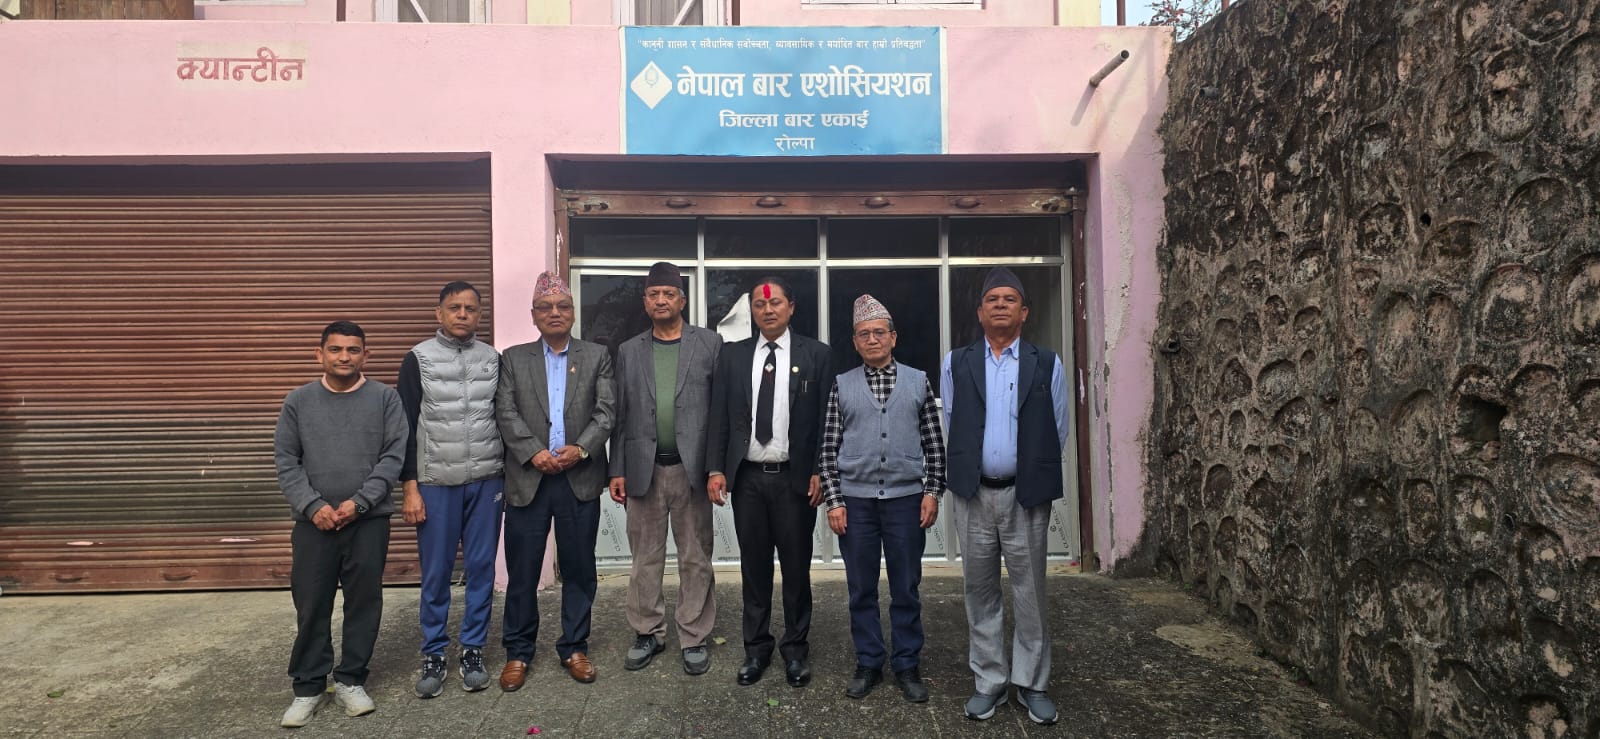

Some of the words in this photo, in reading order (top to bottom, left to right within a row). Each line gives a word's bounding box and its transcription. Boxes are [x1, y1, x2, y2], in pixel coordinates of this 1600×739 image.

[690, 40, 697, 50] र
[817, 40, 824, 49] र
[856, 40, 869, 50] बार
[177, 46, 306, 83] क्यान्टीन
[677, 65, 746, 98] नेपाल
[753, 73, 793, 98] बार
[800, 64, 933, 98] एशोसियशन
[719, 109, 780, 128] जिल्ला
[784, 113, 816, 128] बार
[821, 109, 870, 129] एकाई
[774, 134, 816, 152] रोल्पा
